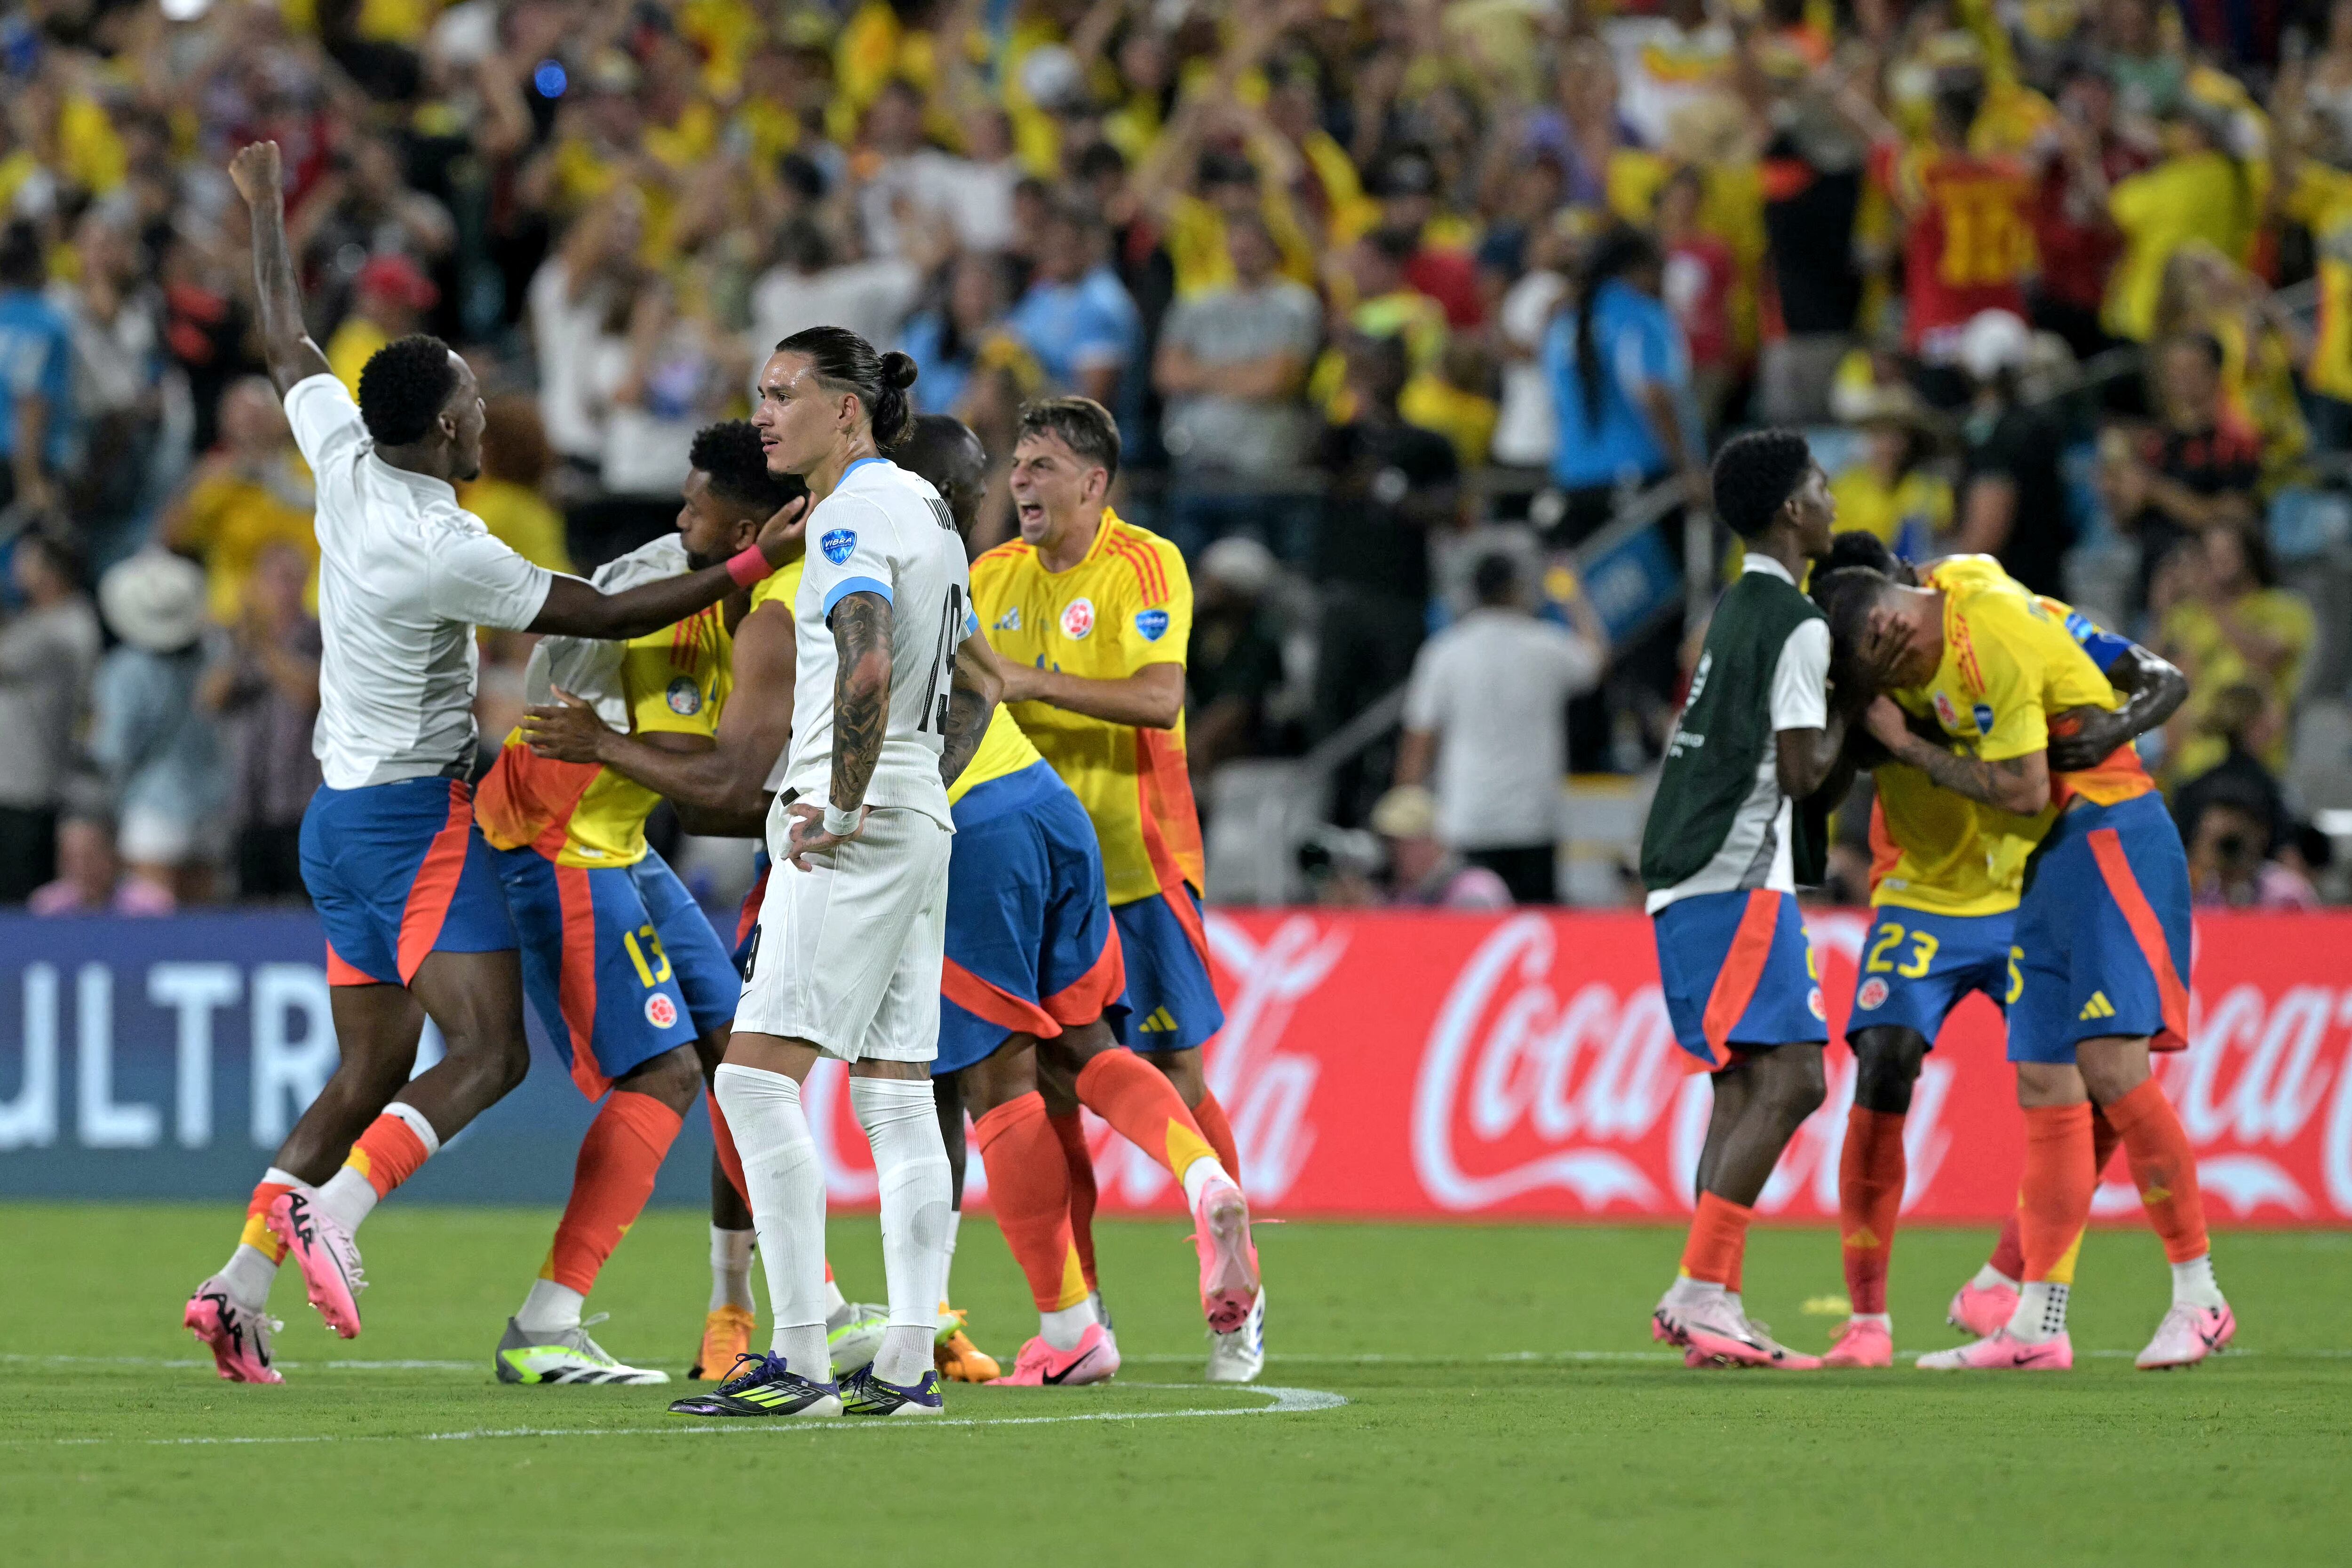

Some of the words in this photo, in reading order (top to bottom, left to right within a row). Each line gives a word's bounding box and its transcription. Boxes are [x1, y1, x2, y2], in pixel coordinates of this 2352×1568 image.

[825, 537, 852, 547] VIBRA
[917, 583, 961, 734] 19
[624, 925, 671, 988] 13
[1866, 923, 1939, 979] 23
[0, 961, 473, 1150] ULTR
[767, 1380, 816, 1397] F50
